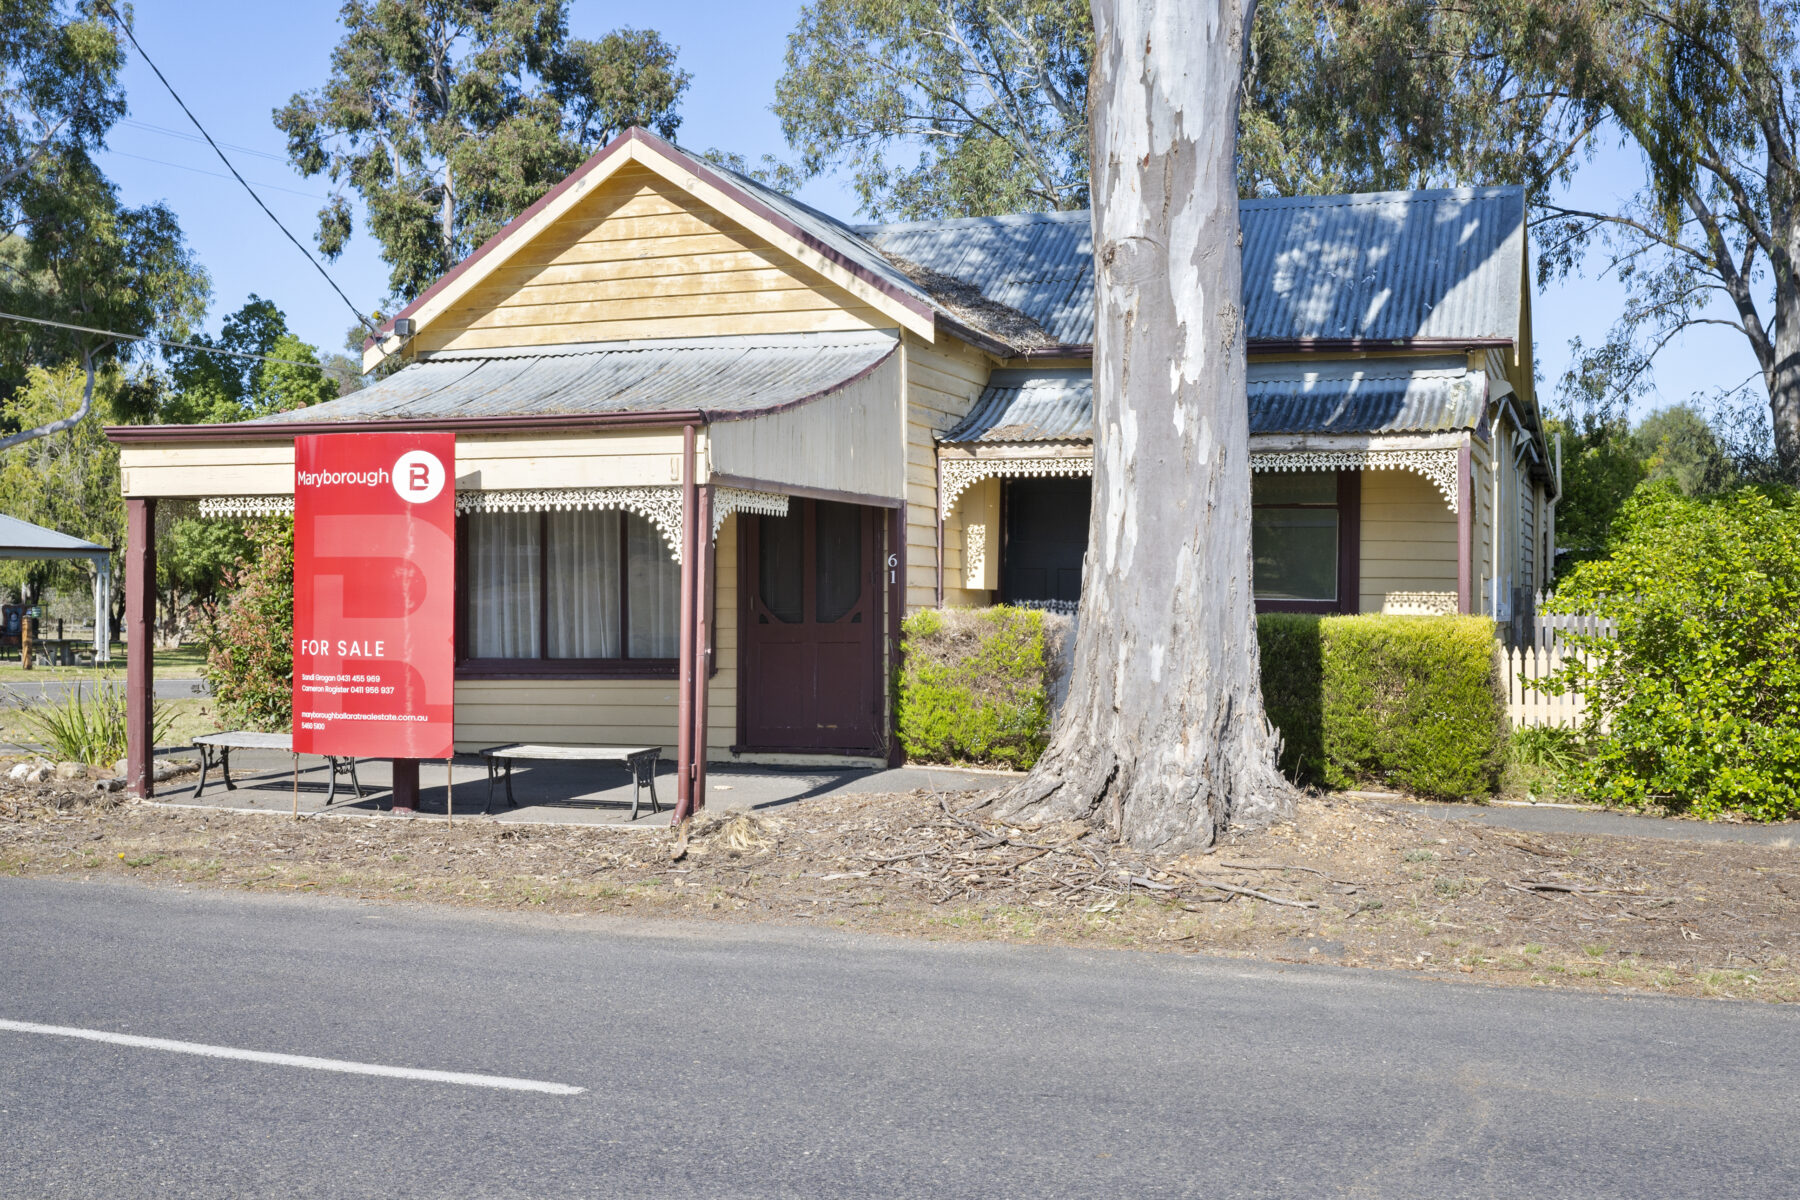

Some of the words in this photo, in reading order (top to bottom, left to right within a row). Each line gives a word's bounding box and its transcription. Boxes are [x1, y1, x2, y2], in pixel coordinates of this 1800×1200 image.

[297, 468, 389, 488] Maryborough
[409, 463, 430, 491] B
[887, 553, 898, 584] 61
[301, 640, 329, 656] FOR
[337, 640, 385, 657] SALE
[336, 674, 351, 683] 0431
[352, 674, 365, 683] 455
[301, 684, 324, 693] Cameron
[350, 686, 364, 694] 0411
[380, 686, 395, 695] 937
[301, 711, 429, 722] maryboroughballaratrealestate.com.au
